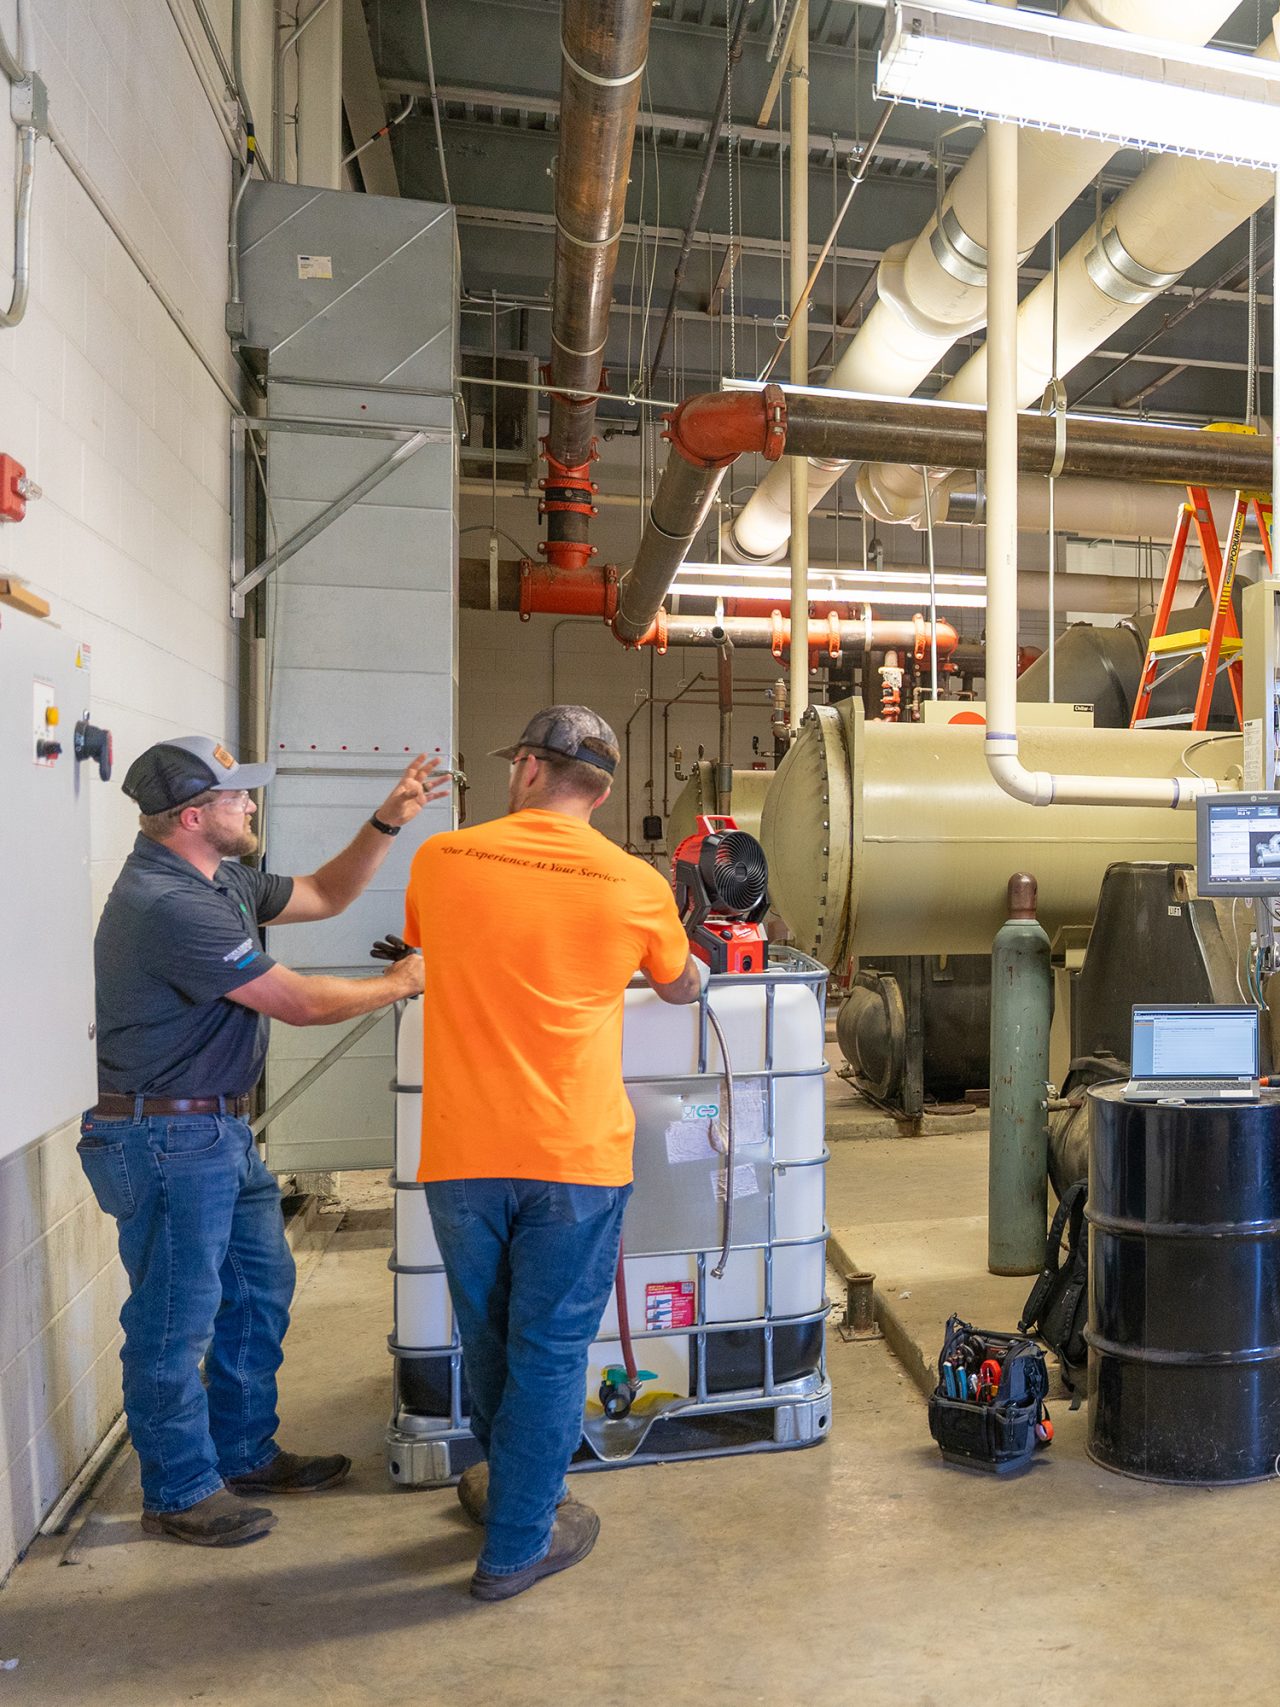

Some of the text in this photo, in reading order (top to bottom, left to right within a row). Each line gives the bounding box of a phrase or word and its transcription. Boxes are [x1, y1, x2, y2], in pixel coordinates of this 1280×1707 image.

[1230, 530, 1241, 562] PODIUM
[465, 848, 530, 866] Experience
[532, 861, 546, 870] At
[549, 863, 576, 874] Your
